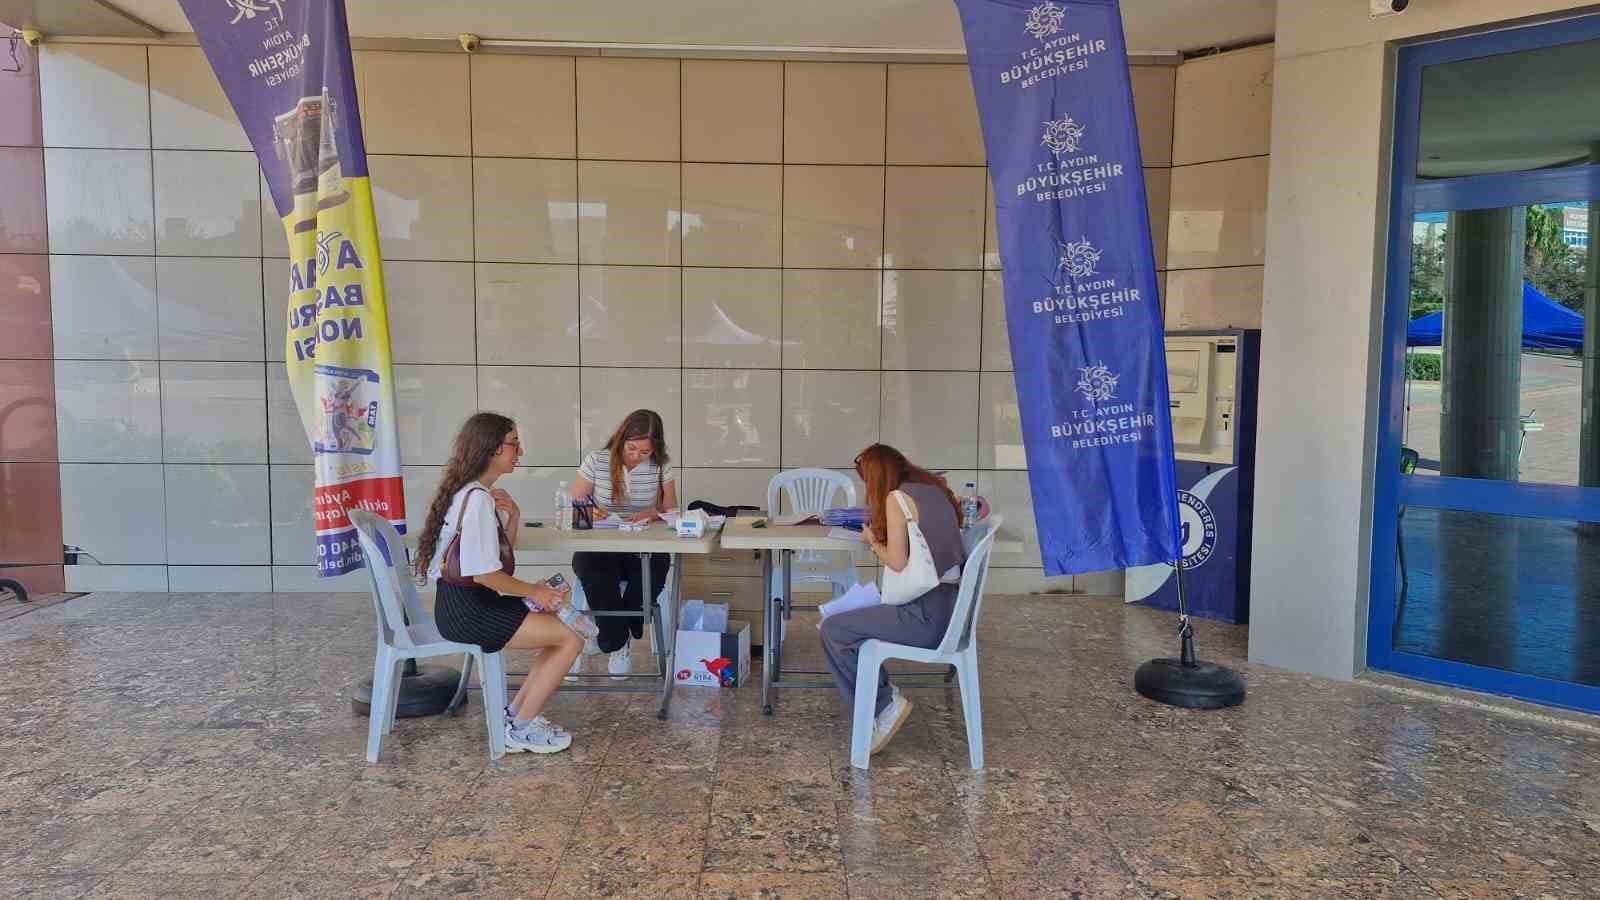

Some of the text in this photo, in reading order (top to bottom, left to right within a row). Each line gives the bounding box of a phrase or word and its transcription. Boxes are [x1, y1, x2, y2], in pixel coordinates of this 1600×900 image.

[1044, 32, 1080, 51] AYDIN
[1000, 39, 1106, 85] BÜYÜKŞEHİR
[1021, 58, 1088, 89] BELEDİYESİ
[1060, 154, 1099, 170] AYDIN
[1016, 162, 1125, 197] BÜYÜKŞEHİR
[1036, 181, 1107, 202] BELEDİYESİ
[1077, 278, 1116, 293] AYDIN
[1032, 287, 1141, 314] BÜYÜKŞEHİR
[1055, 305, 1124, 324] BELEDİYESİ
[1095, 402, 1134, 417] AYDIN
[1051, 412, 1154, 438] BÜYÜKŞEHİR
[1072, 430, 1142, 449] BELEDİYESİ
